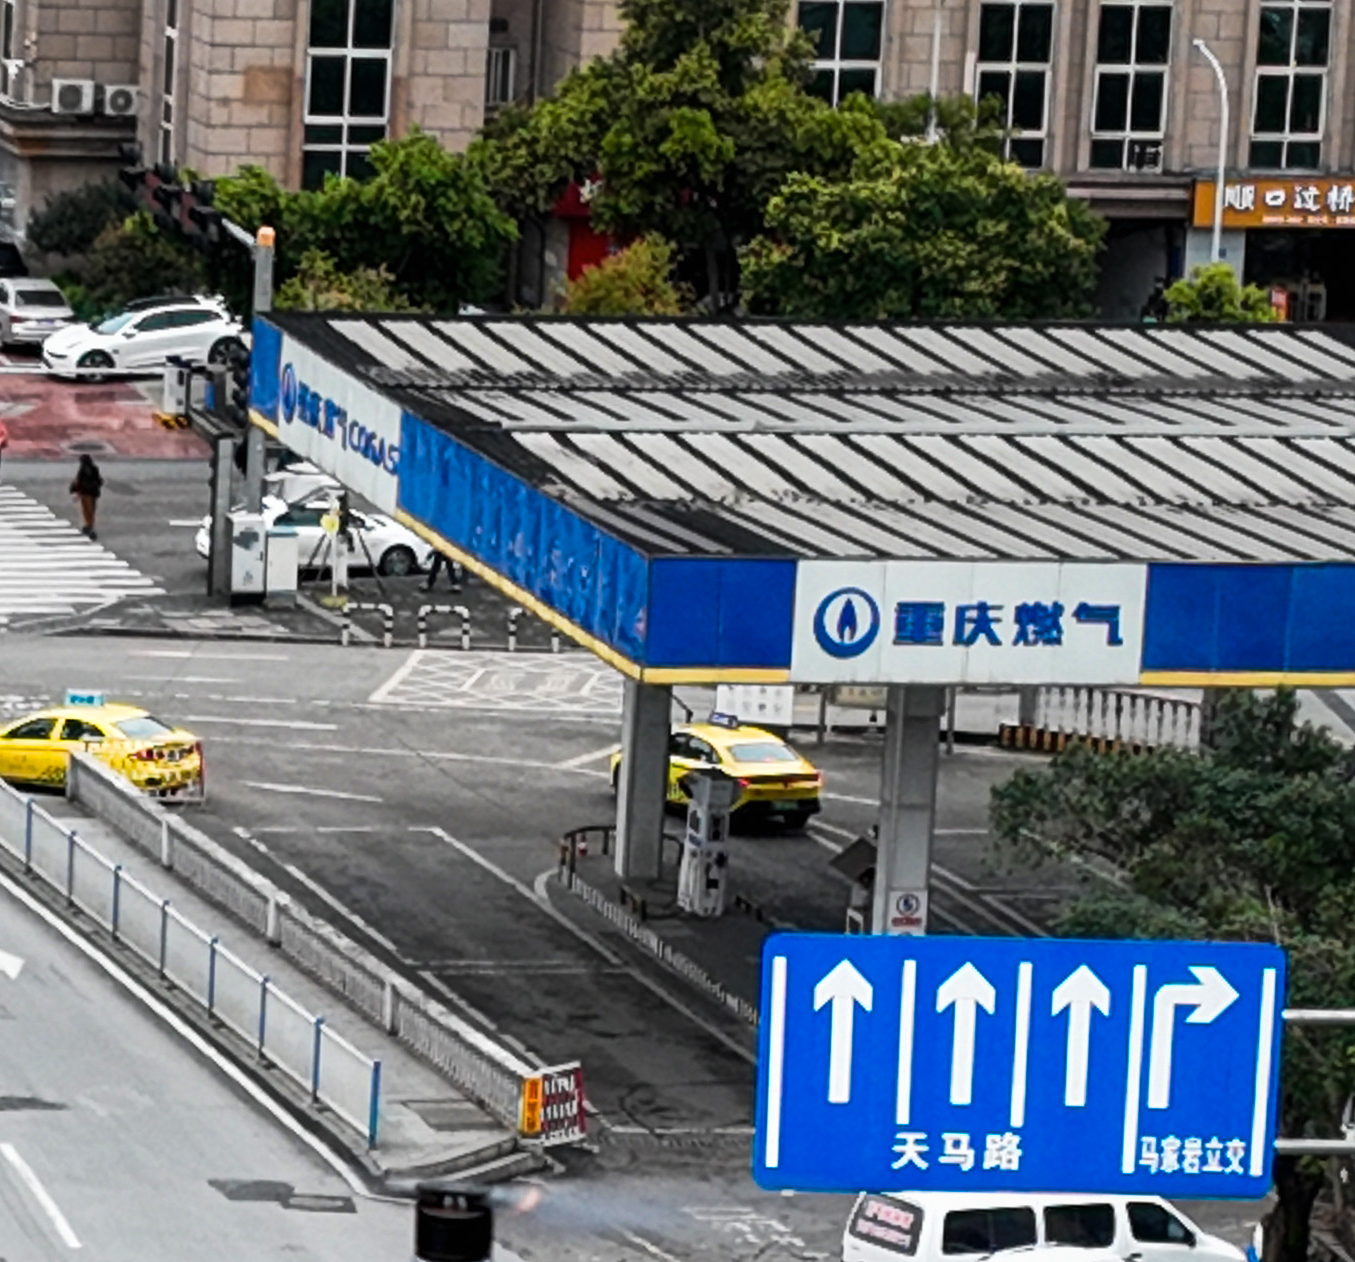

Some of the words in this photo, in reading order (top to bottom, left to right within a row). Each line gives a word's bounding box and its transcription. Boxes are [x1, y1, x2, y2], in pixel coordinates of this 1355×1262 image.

[893, 600, 1123, 646] 重庆燃气
[891, 1131, 1023, 1171] 天马路
[1139, 1134, 1247, 1174] 马家岩立交
